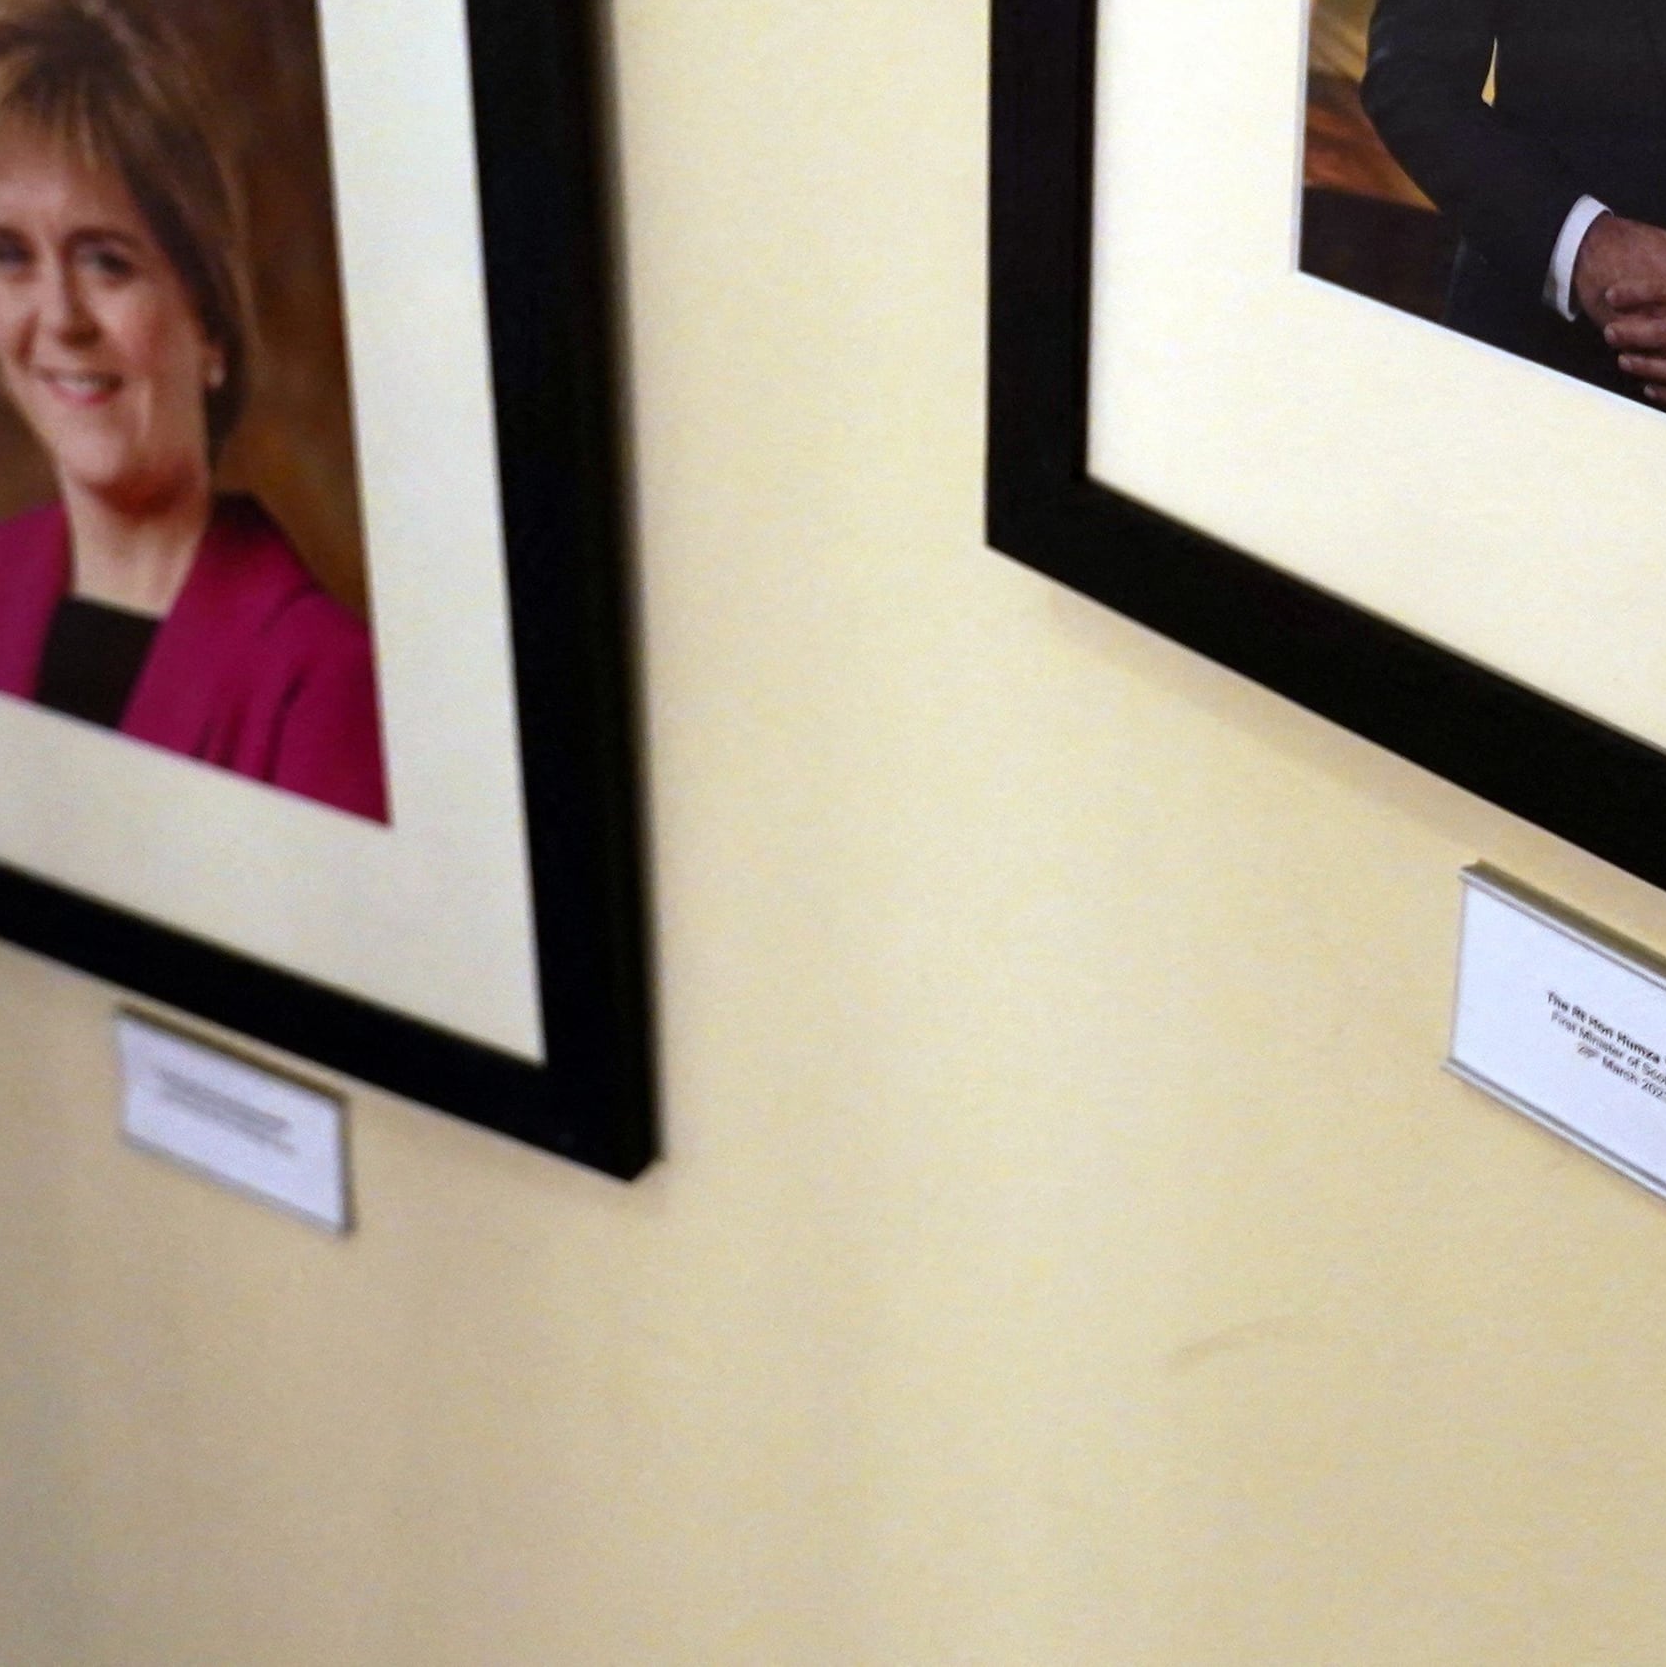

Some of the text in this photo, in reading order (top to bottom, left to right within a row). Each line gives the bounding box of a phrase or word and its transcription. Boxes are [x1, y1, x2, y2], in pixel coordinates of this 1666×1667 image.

[1547, 990, 1569, 1012] The
[1572, 1005, 1587, 1022] Rt
[1589, 1015, 1613, 1039] Hon
[1617, 1031, 1660, 1064] Humza
[1551, 1010, 1576, 1033] First
[1579, 1027, 1623, 1058] Minister
[1628, 1056, 1641, 1069] of
[1602, 1055, 1637, 1084] March
